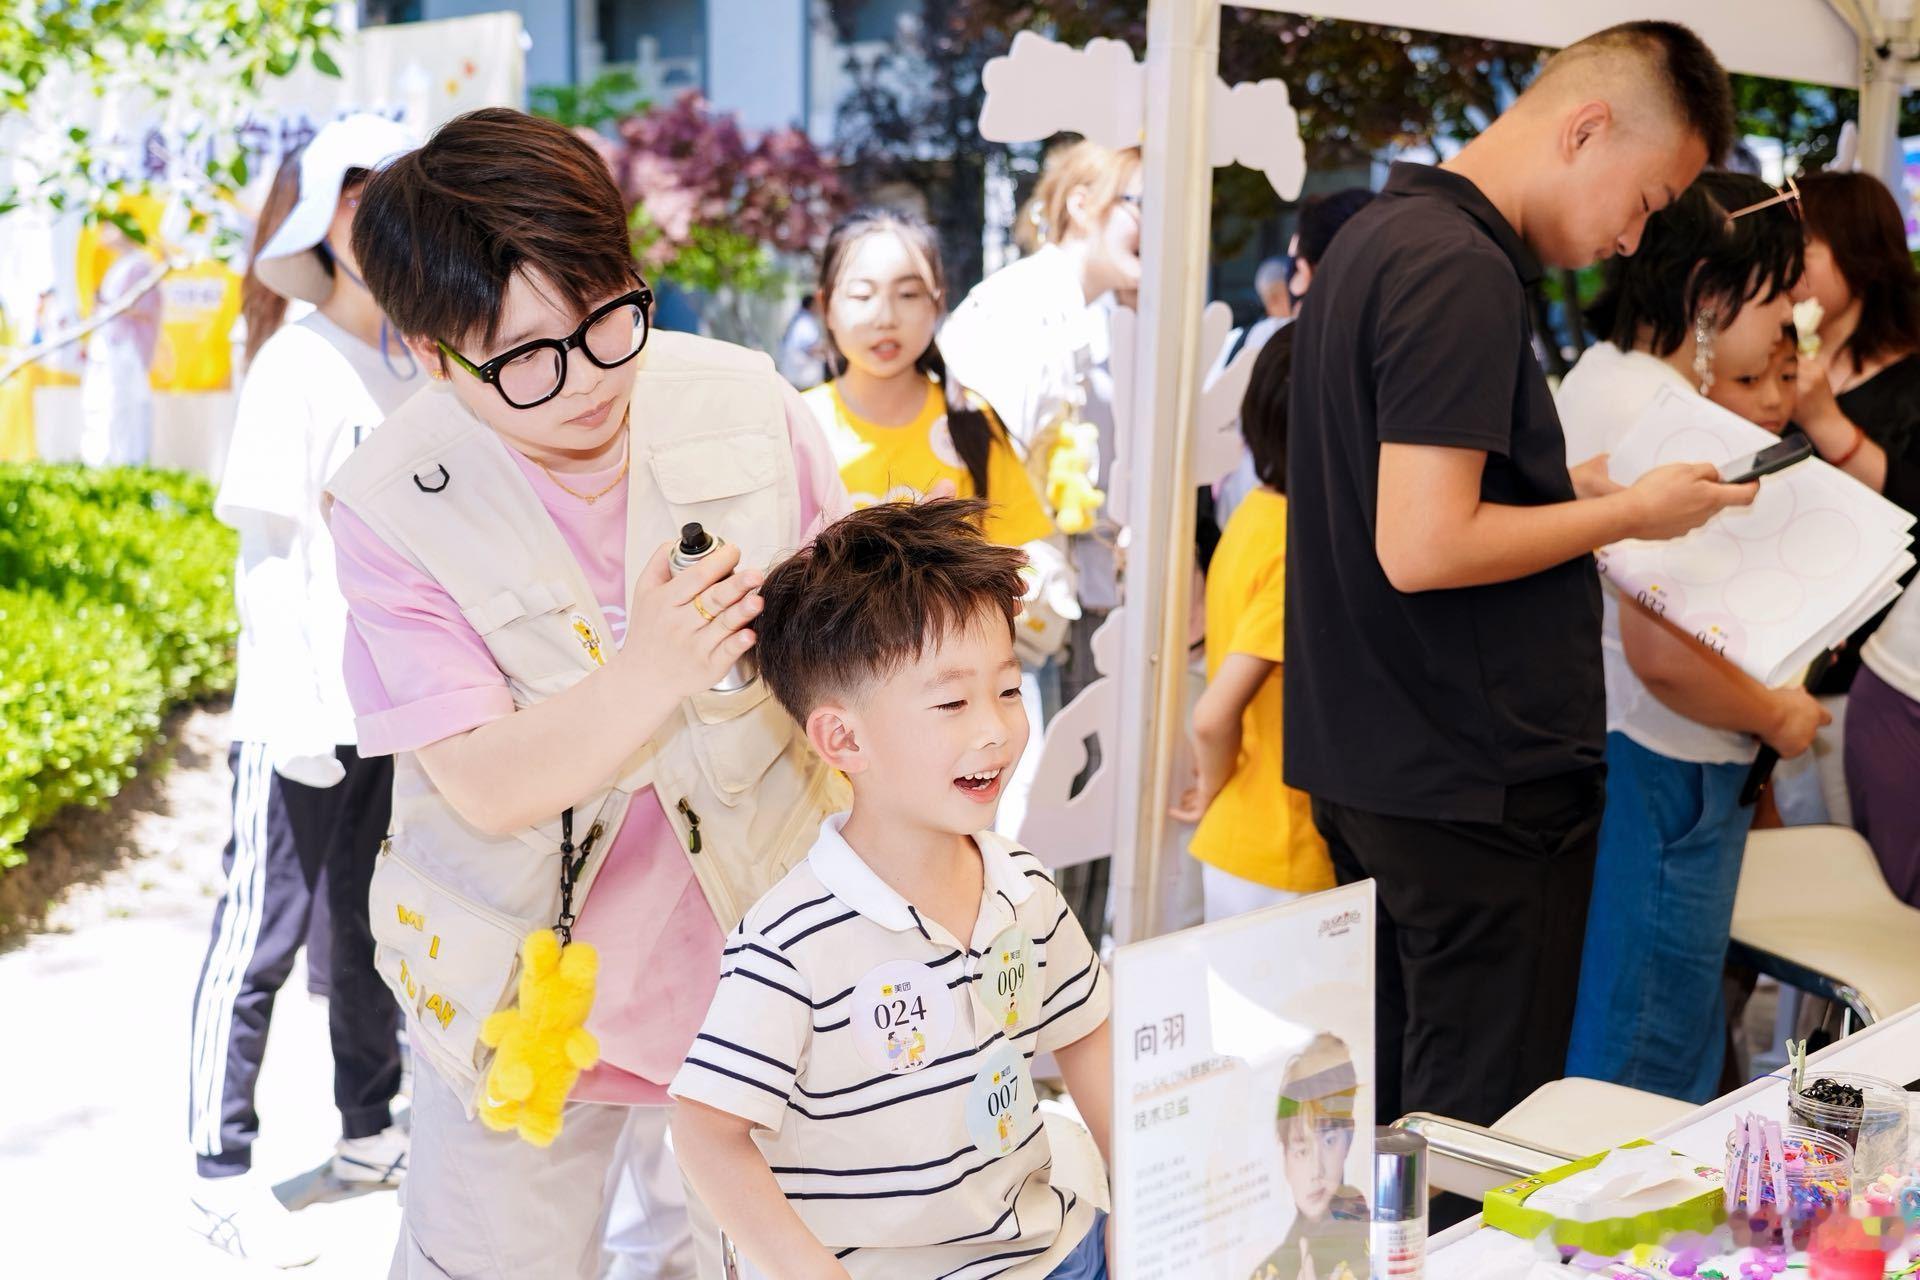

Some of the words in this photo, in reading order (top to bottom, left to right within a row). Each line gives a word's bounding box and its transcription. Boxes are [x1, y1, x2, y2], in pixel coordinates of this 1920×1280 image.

[401, 959, 456, 1031] TUAN
[894, 981, 912, 993] 美团
[998, 963, 1025, 996] 009
[874, 995, 927, 1030] 024
[1134, 1013, 1185, 1060] 向羽
[988, 1075, 1018, 1117] 007
